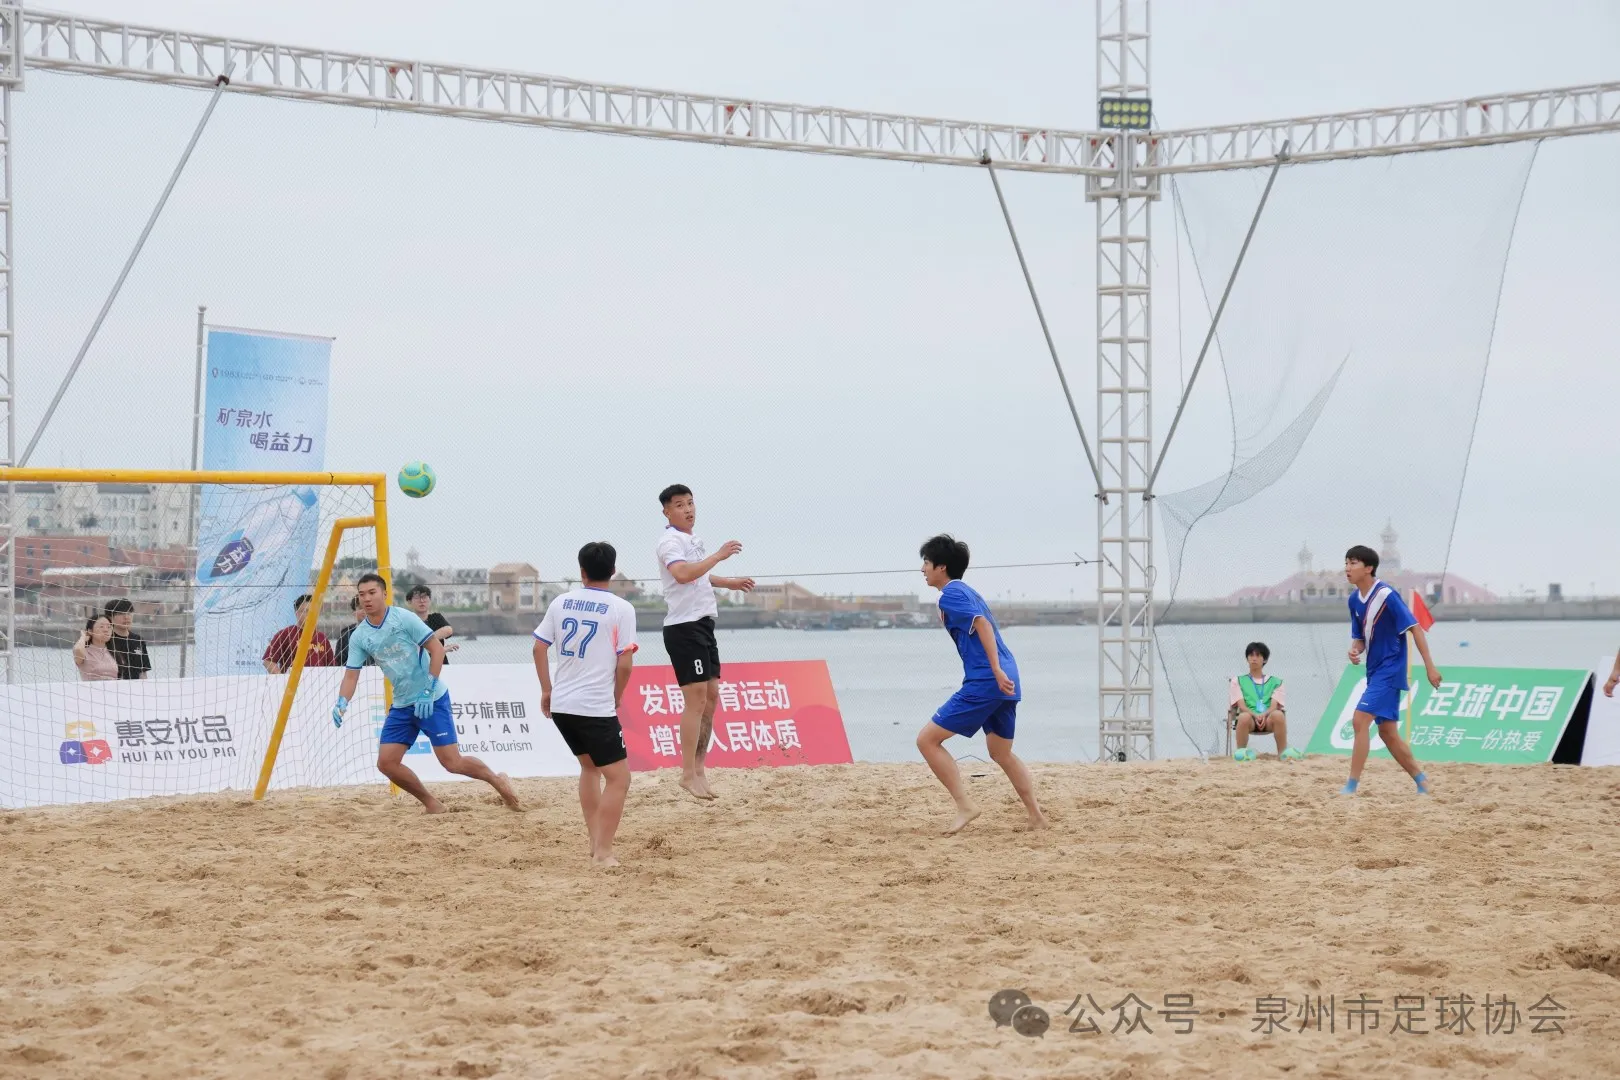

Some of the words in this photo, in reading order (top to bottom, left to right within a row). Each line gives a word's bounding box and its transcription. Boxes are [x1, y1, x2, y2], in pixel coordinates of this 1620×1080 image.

[217, 408, 273, 428] 矿泉水
[250, 431, 313, 453] 喝益力
[560, 617, 599, 658] 27
[694, 659, 704, 675] 8
[639, 679, 791, 716] 发展育运动
[1420, 682, 1564, 721] 足球中国
[114, 715, 232, 747] 惠安优品
[1409, 725, 1543, 751] 记录每一份热爱
[122, 752, 148, 763] HUI
[180, 748, 208, 760] YOU
[480, 740, 489, 752] &
[489, 740, 533, 752] Tourism
